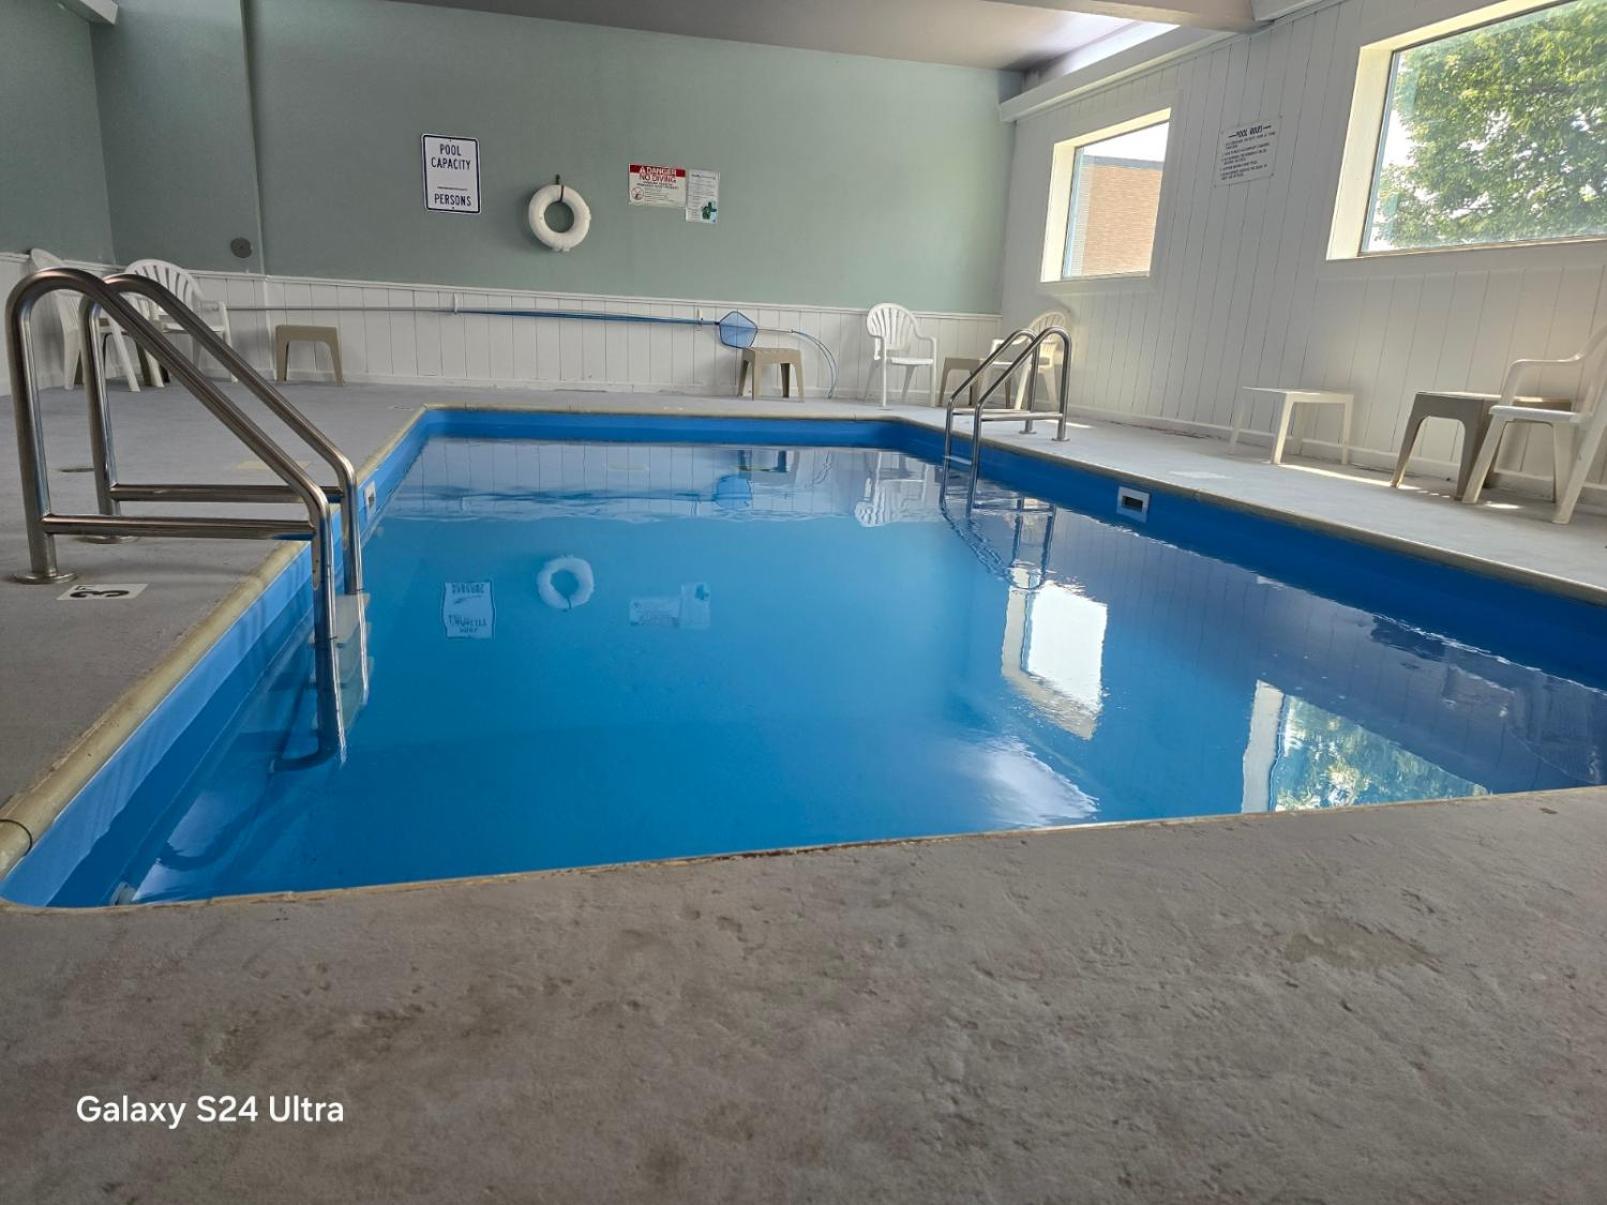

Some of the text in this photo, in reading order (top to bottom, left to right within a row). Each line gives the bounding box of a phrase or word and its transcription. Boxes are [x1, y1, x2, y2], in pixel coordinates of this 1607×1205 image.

[440, 143, 462, 156] POOL
[431, 157, 471, 170] CAPACITY
[646, 166, 677, 177] DANGER
[651, 174, 677, 184] DIVING
[434, 193, 472, 207] PERSONS
[69, 590, 130, 598] 3
